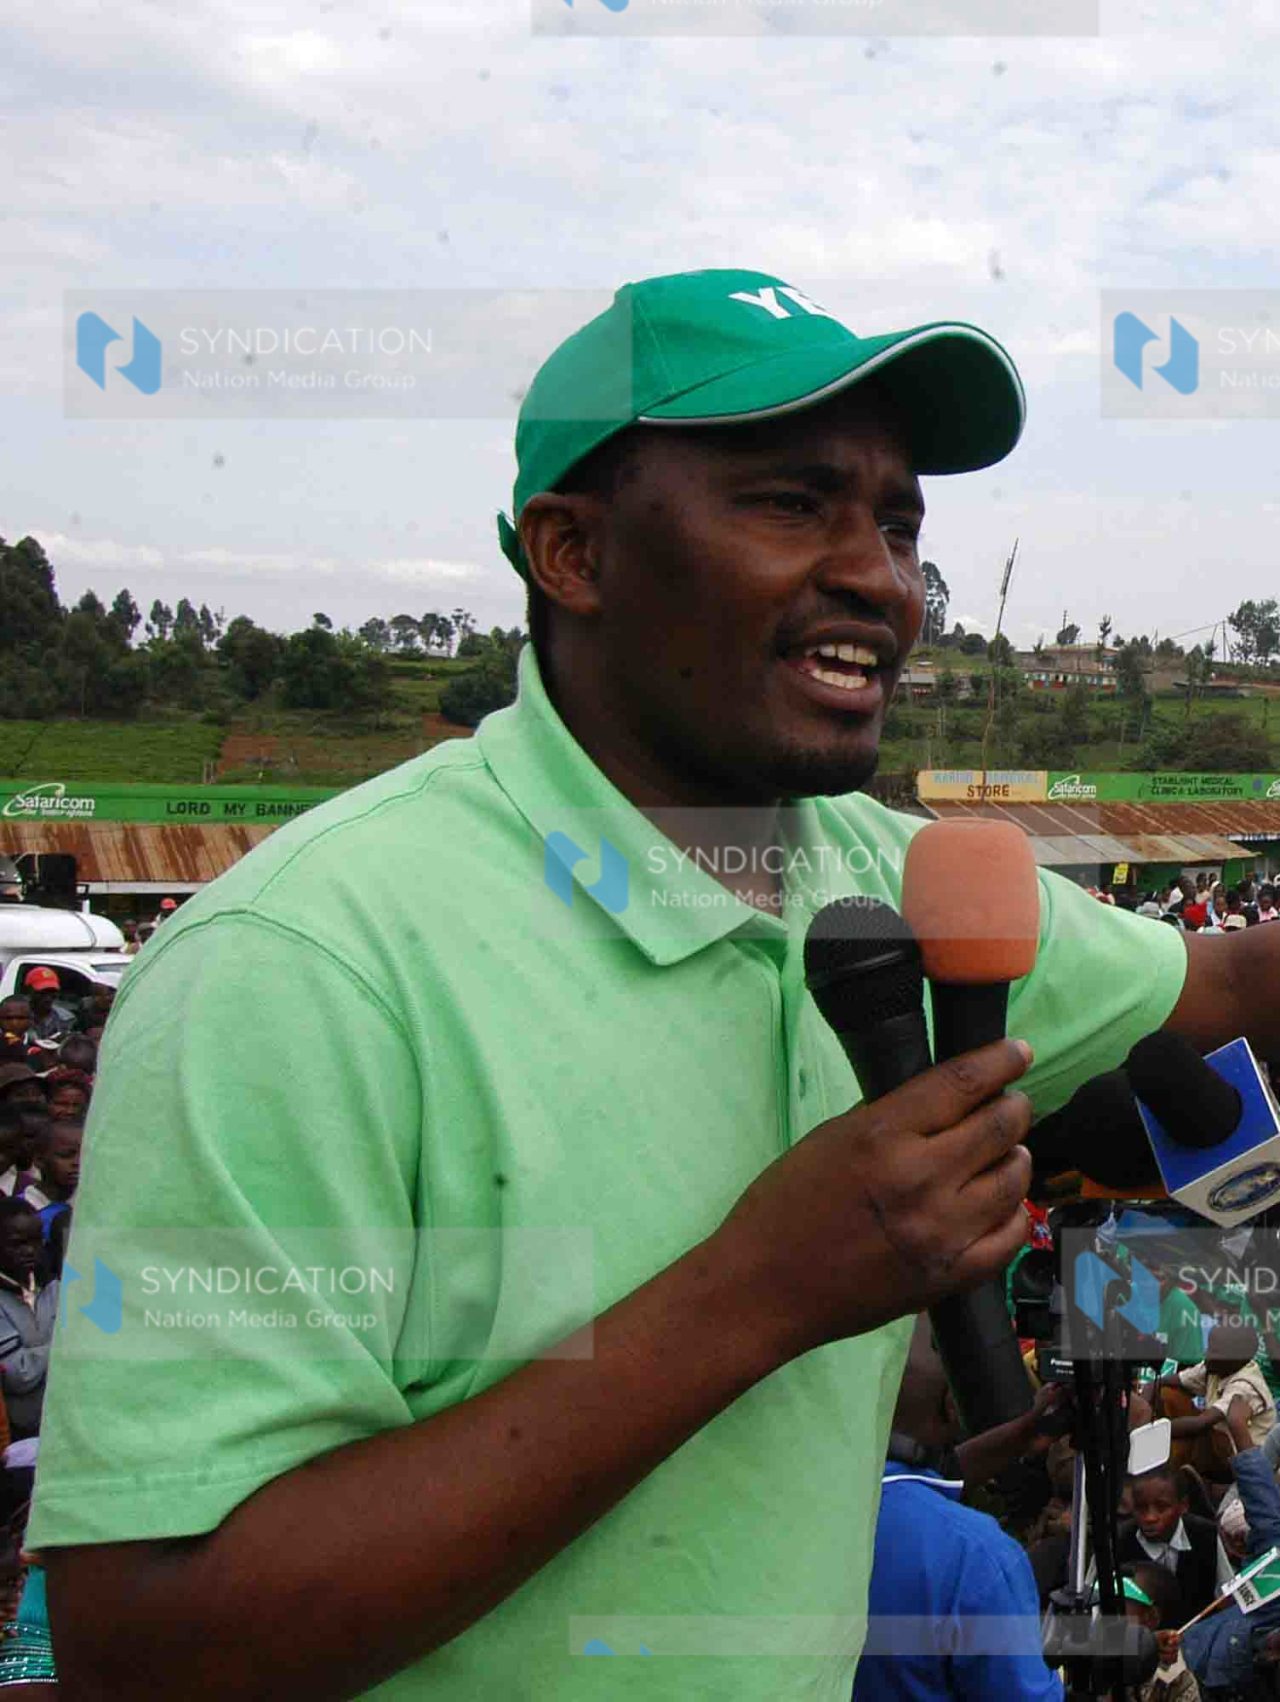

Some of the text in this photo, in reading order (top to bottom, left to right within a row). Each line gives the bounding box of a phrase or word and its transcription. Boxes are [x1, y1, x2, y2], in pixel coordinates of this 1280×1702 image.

[967, 784, 1010, 797] STORE
[15, 794, 96, 810] Safaricom
[166, 801, 310, 817] LORD MY BANNE
